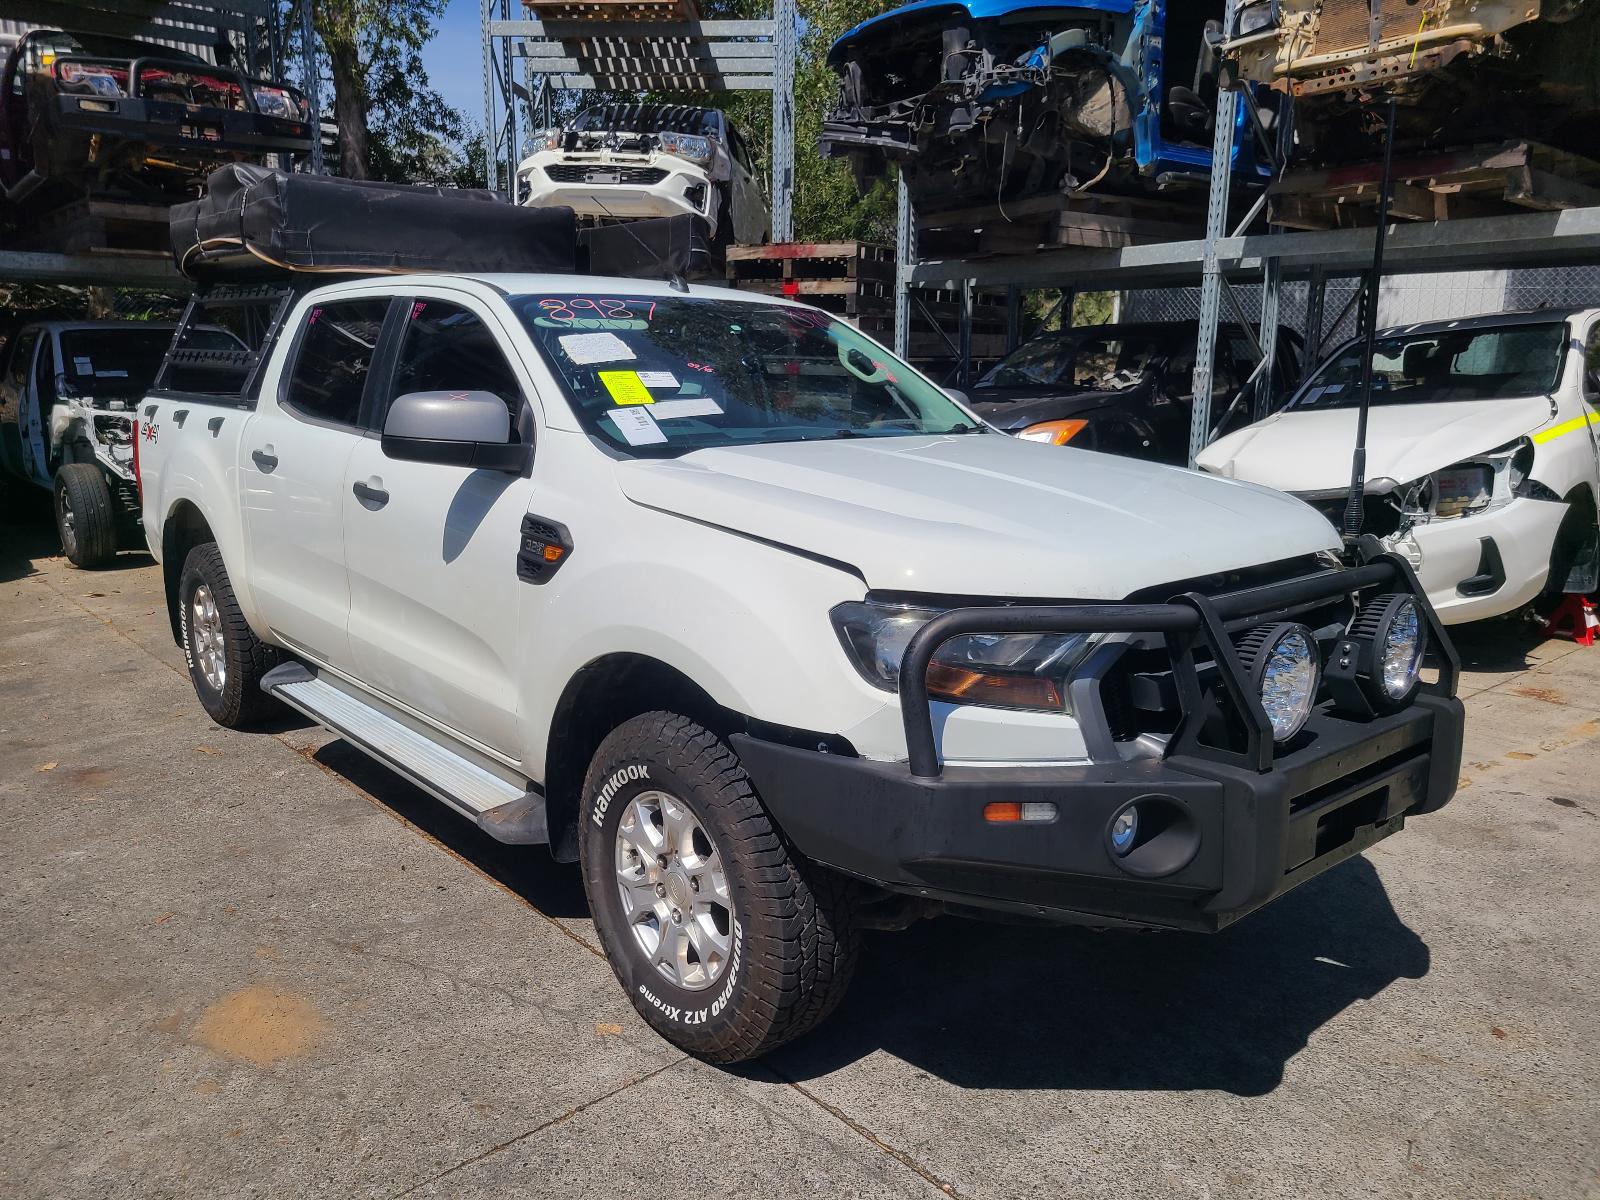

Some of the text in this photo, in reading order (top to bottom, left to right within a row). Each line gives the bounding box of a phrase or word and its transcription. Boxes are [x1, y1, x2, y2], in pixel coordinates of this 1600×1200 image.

[539, 298, 656, 320] 8987
[639, 984, 681, 1022] Xtreme
[684, 1007, 708, 1025] AT2
